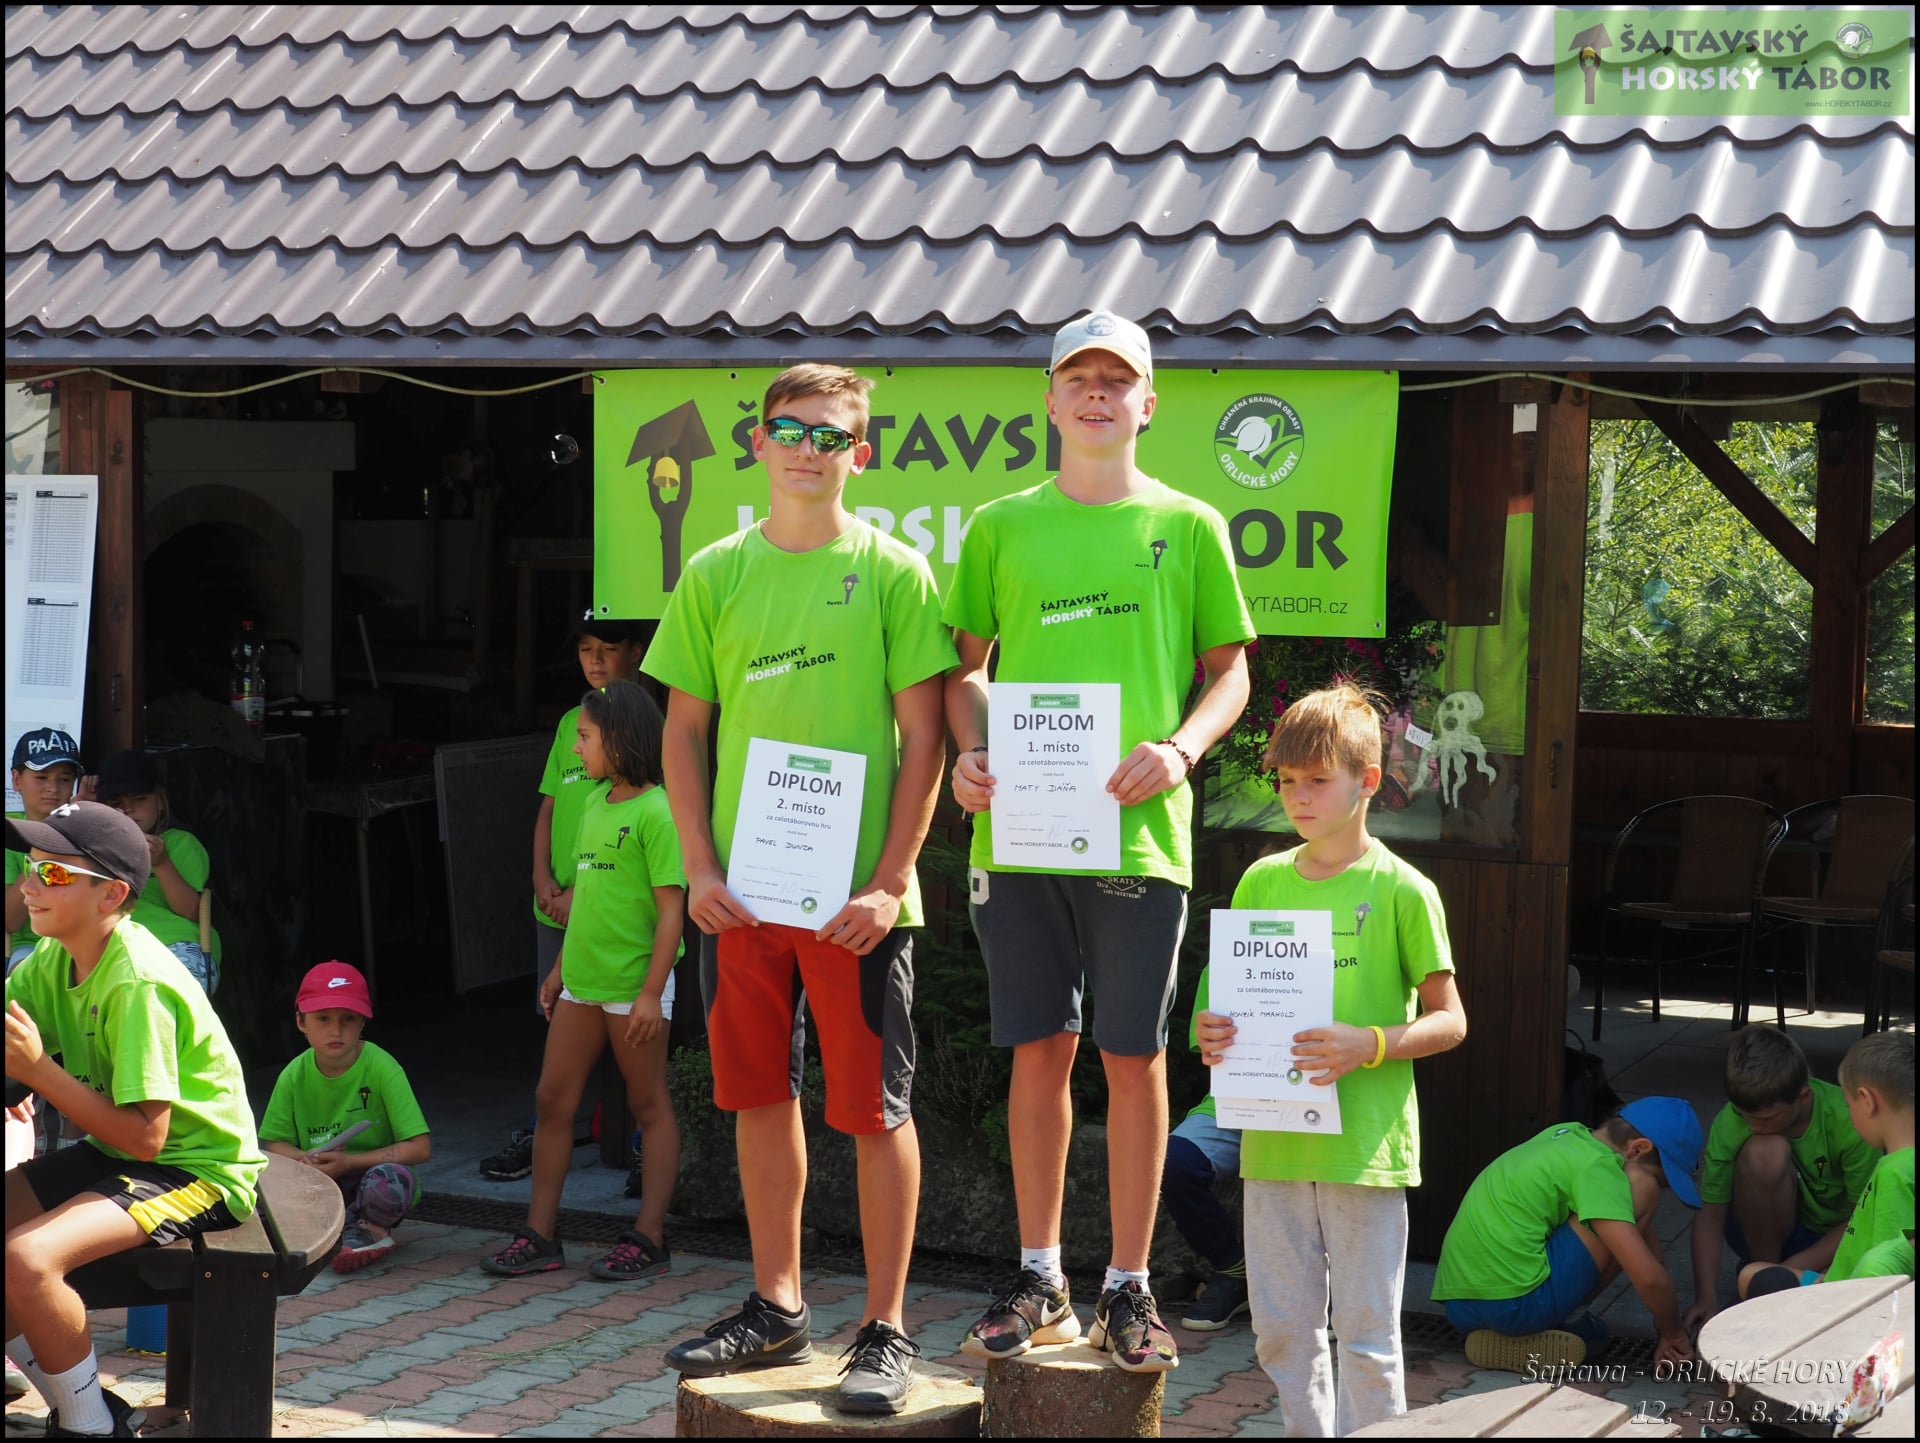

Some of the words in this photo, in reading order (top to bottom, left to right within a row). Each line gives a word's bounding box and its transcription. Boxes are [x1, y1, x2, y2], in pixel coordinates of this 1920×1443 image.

[1282, 405, 1301, 430] OBLAST
[1220, 453, 1268, 487] ORLICKÉ
[1269, 451, 1299, 483] HORY
[1040, 590, 1109, 612] ŠAJTAVSKÝ
[1041, 605, 1094, 626] HORSKÝ
[1096, 603, 1140, 615] TÁBOR
[746, 644, 806, 669] AJTAVSKÝ
[745, 662, 792, 683] HORSKÝ
[794, 652, 836, 670] TÁBOR
[1013, 714, 1094, 731] DIPLOM
[1027, 741, 1039, 753] 1.
[1043, 741, 1080, 753] místo
[767, 770, 842, 797] DIPLOM
[1014, 784, 1040, 792] MATY
[776, 798, 788, 810] 2.
[791, 801, 826, 816] místo
[774, 816, 820, 828] celotáborovou
[820, 822, 832, 830] hru
[755, 837, 777, 847] PAVEL
[1232, 940, 1308, 959] DIPLOM
[1245, 968, 1257, 980] 3.
[1260, 968, 1295, 981] místo
[1245, 986, 1291, 994] celotáborovou
